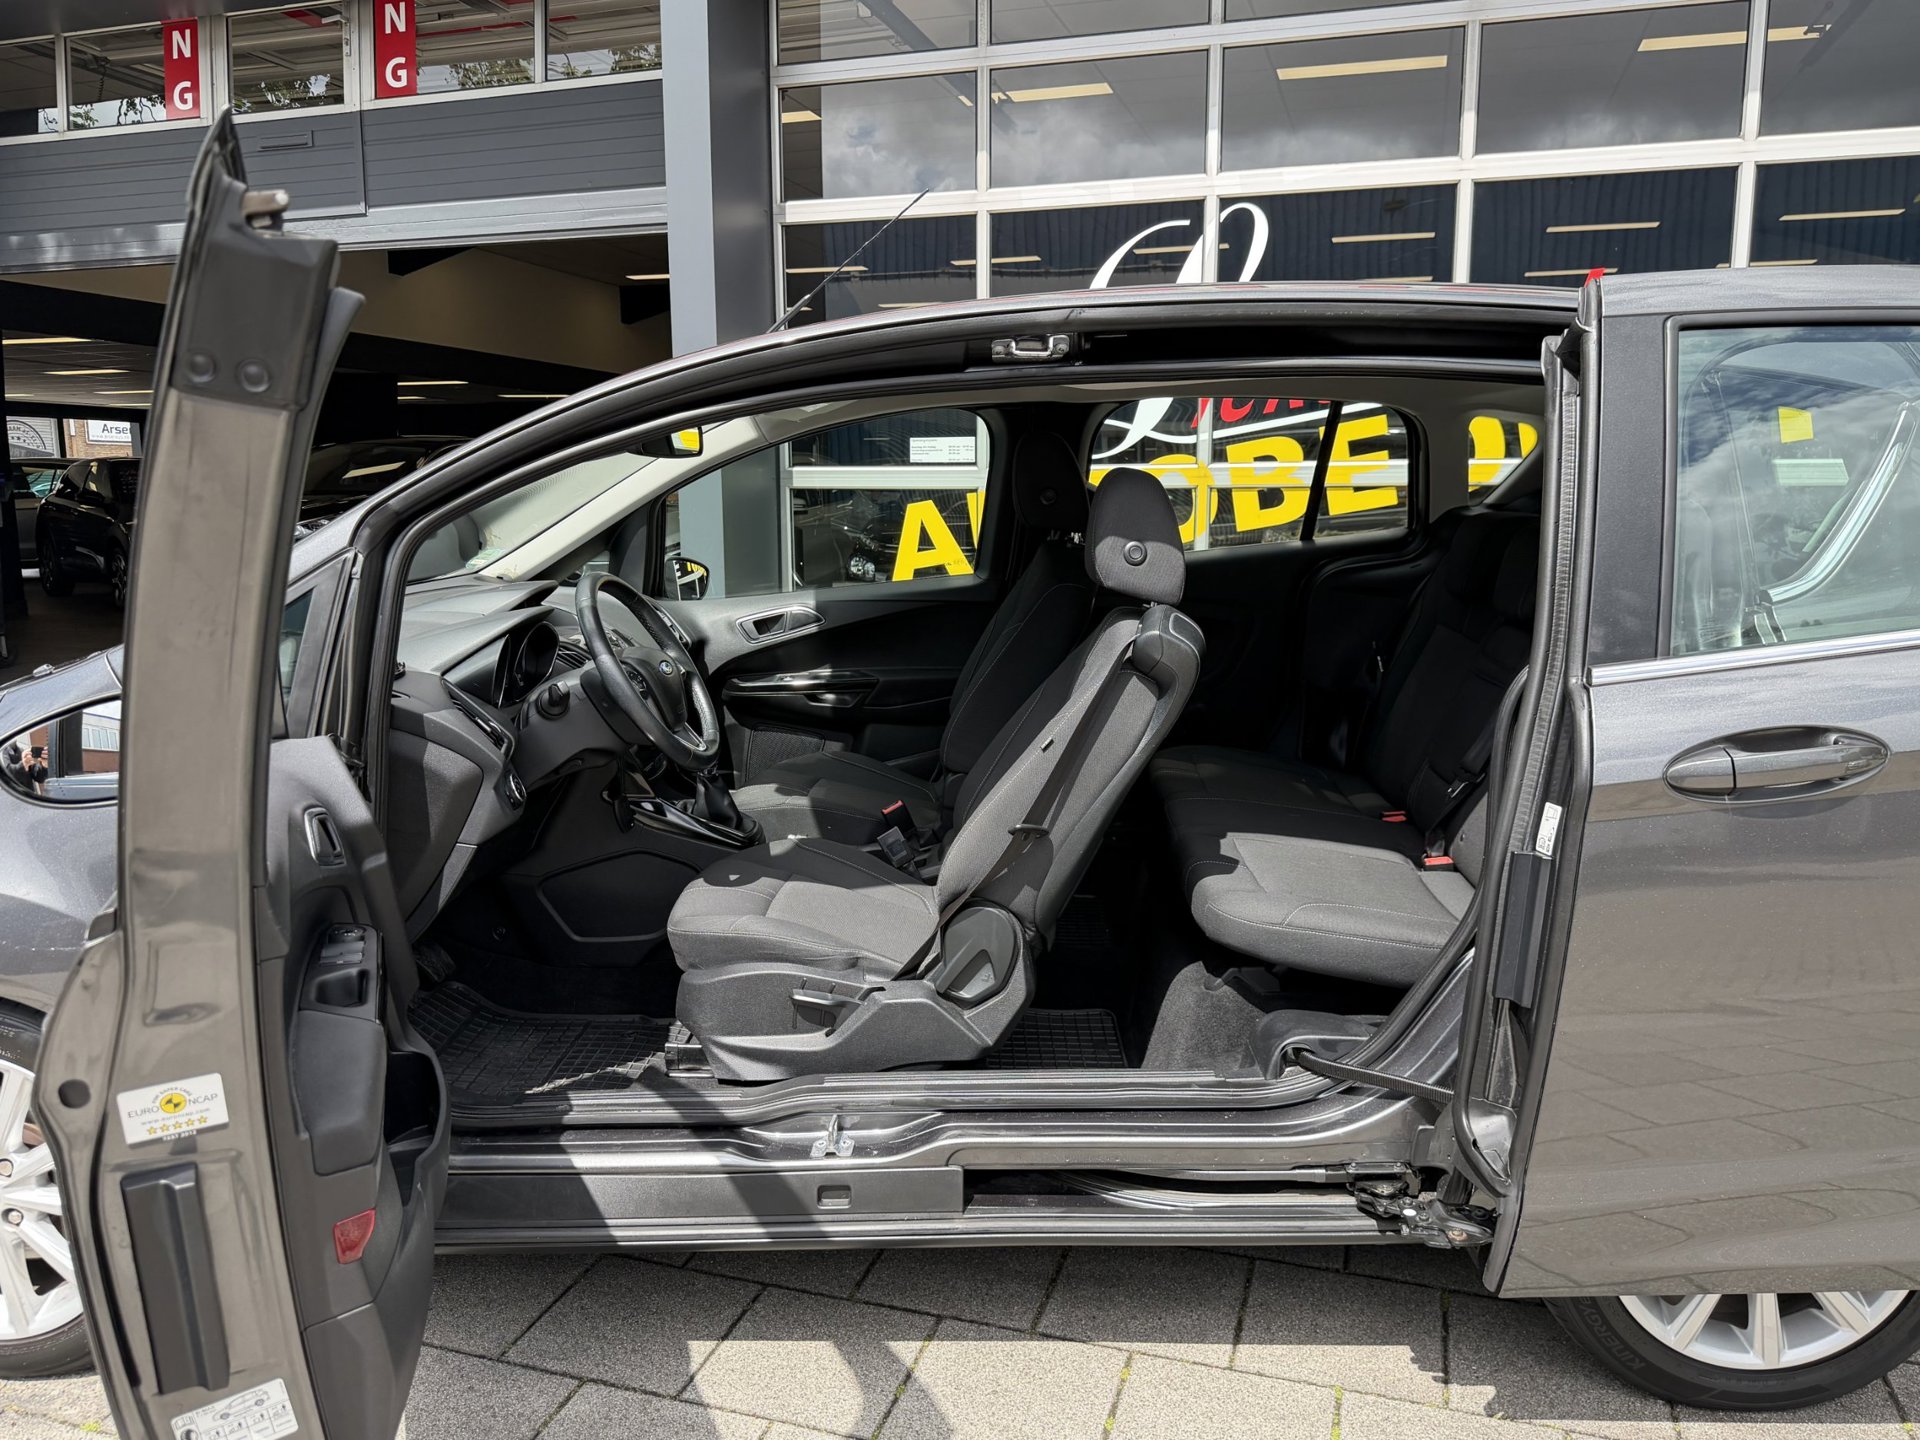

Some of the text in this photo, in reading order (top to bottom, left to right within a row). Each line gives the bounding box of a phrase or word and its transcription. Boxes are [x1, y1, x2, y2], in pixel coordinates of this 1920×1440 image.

[102, 423, 131, 435] Arse
[127, 1093, 218, 1119] EURO NCAP
[1578, 1303, 1647, 1371] KINERGY
